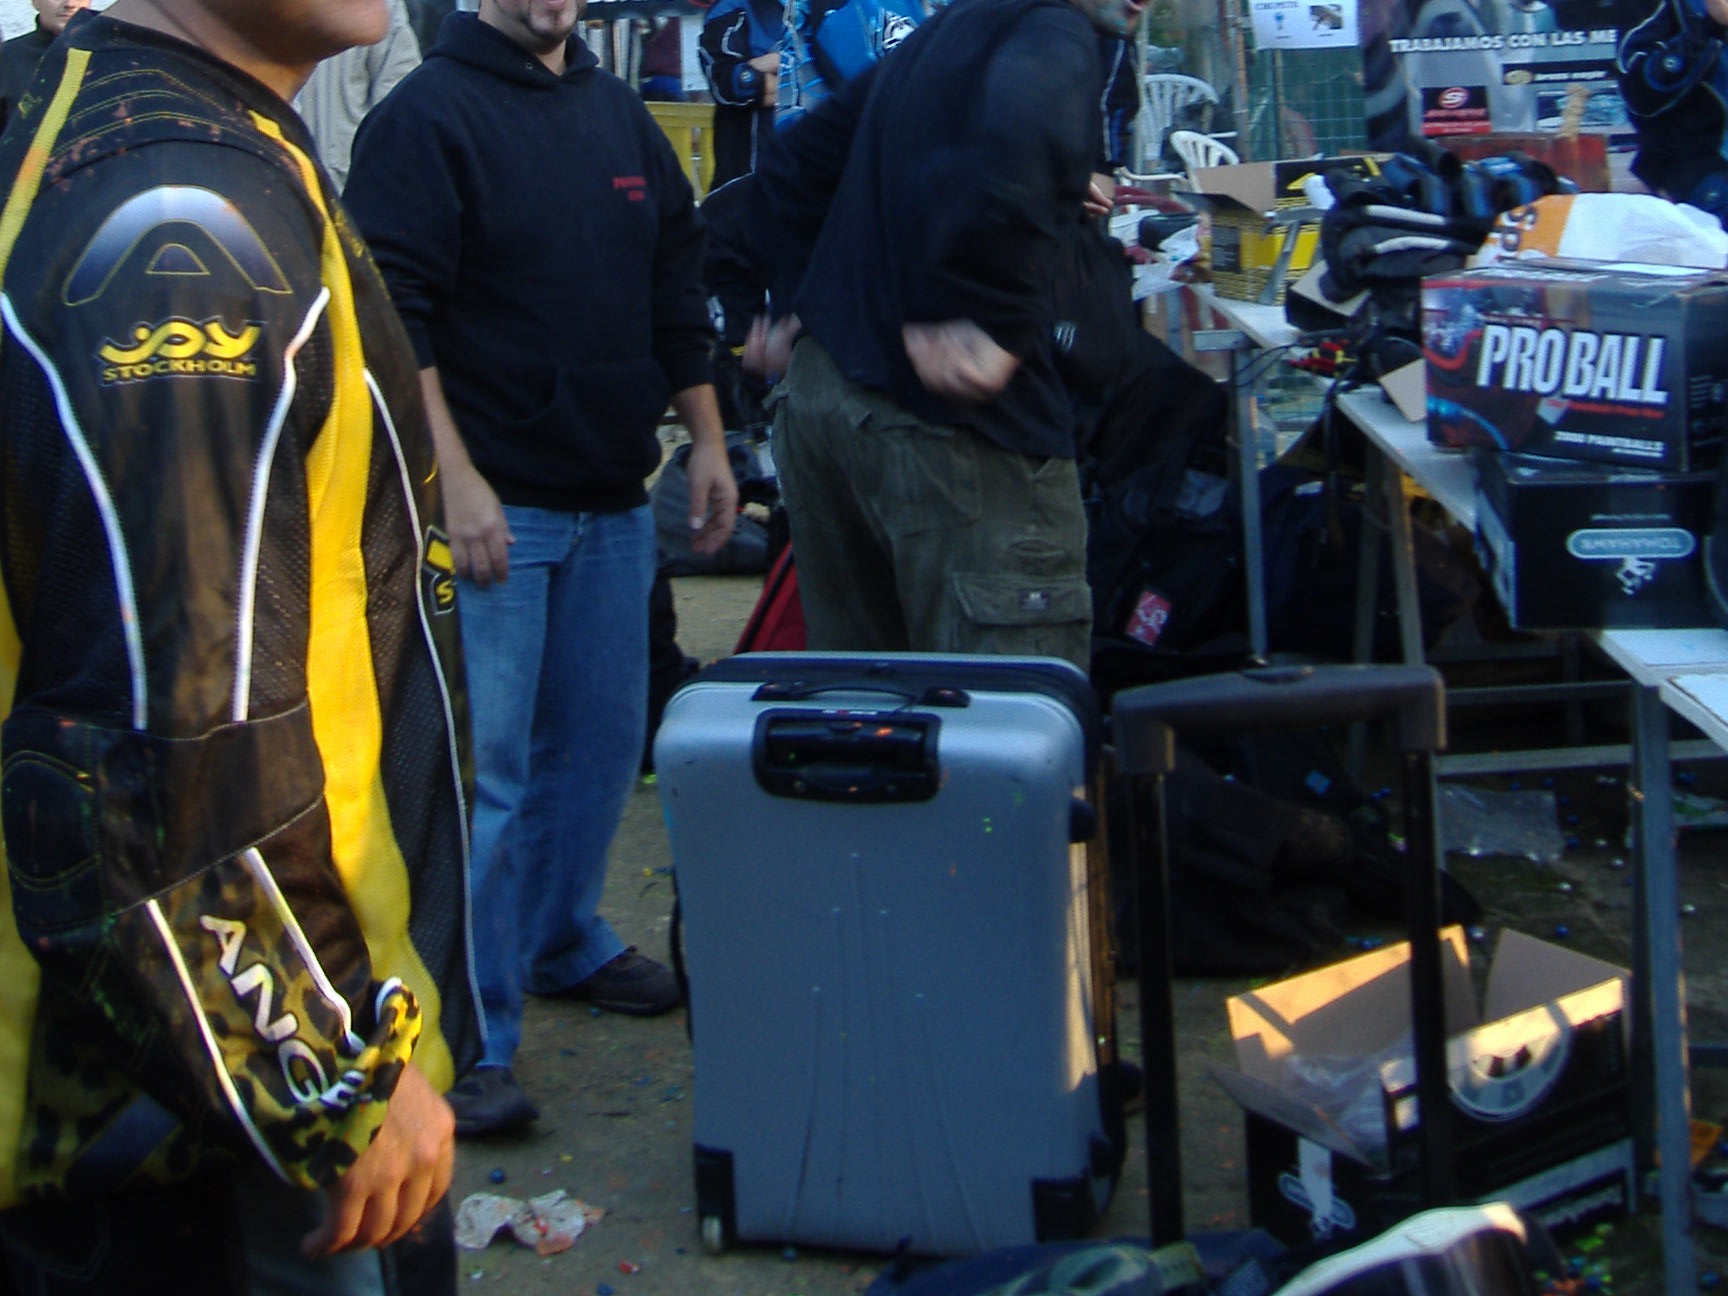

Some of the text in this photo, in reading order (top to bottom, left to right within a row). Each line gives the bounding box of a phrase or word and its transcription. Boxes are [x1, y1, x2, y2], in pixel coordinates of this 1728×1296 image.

[1388, 29, 1618, 53] TRABAJAMOS CON LAS ME
[102, 358, 257, 382] STOCKHOLM
[200, 914, 373, 1108] ANGE
